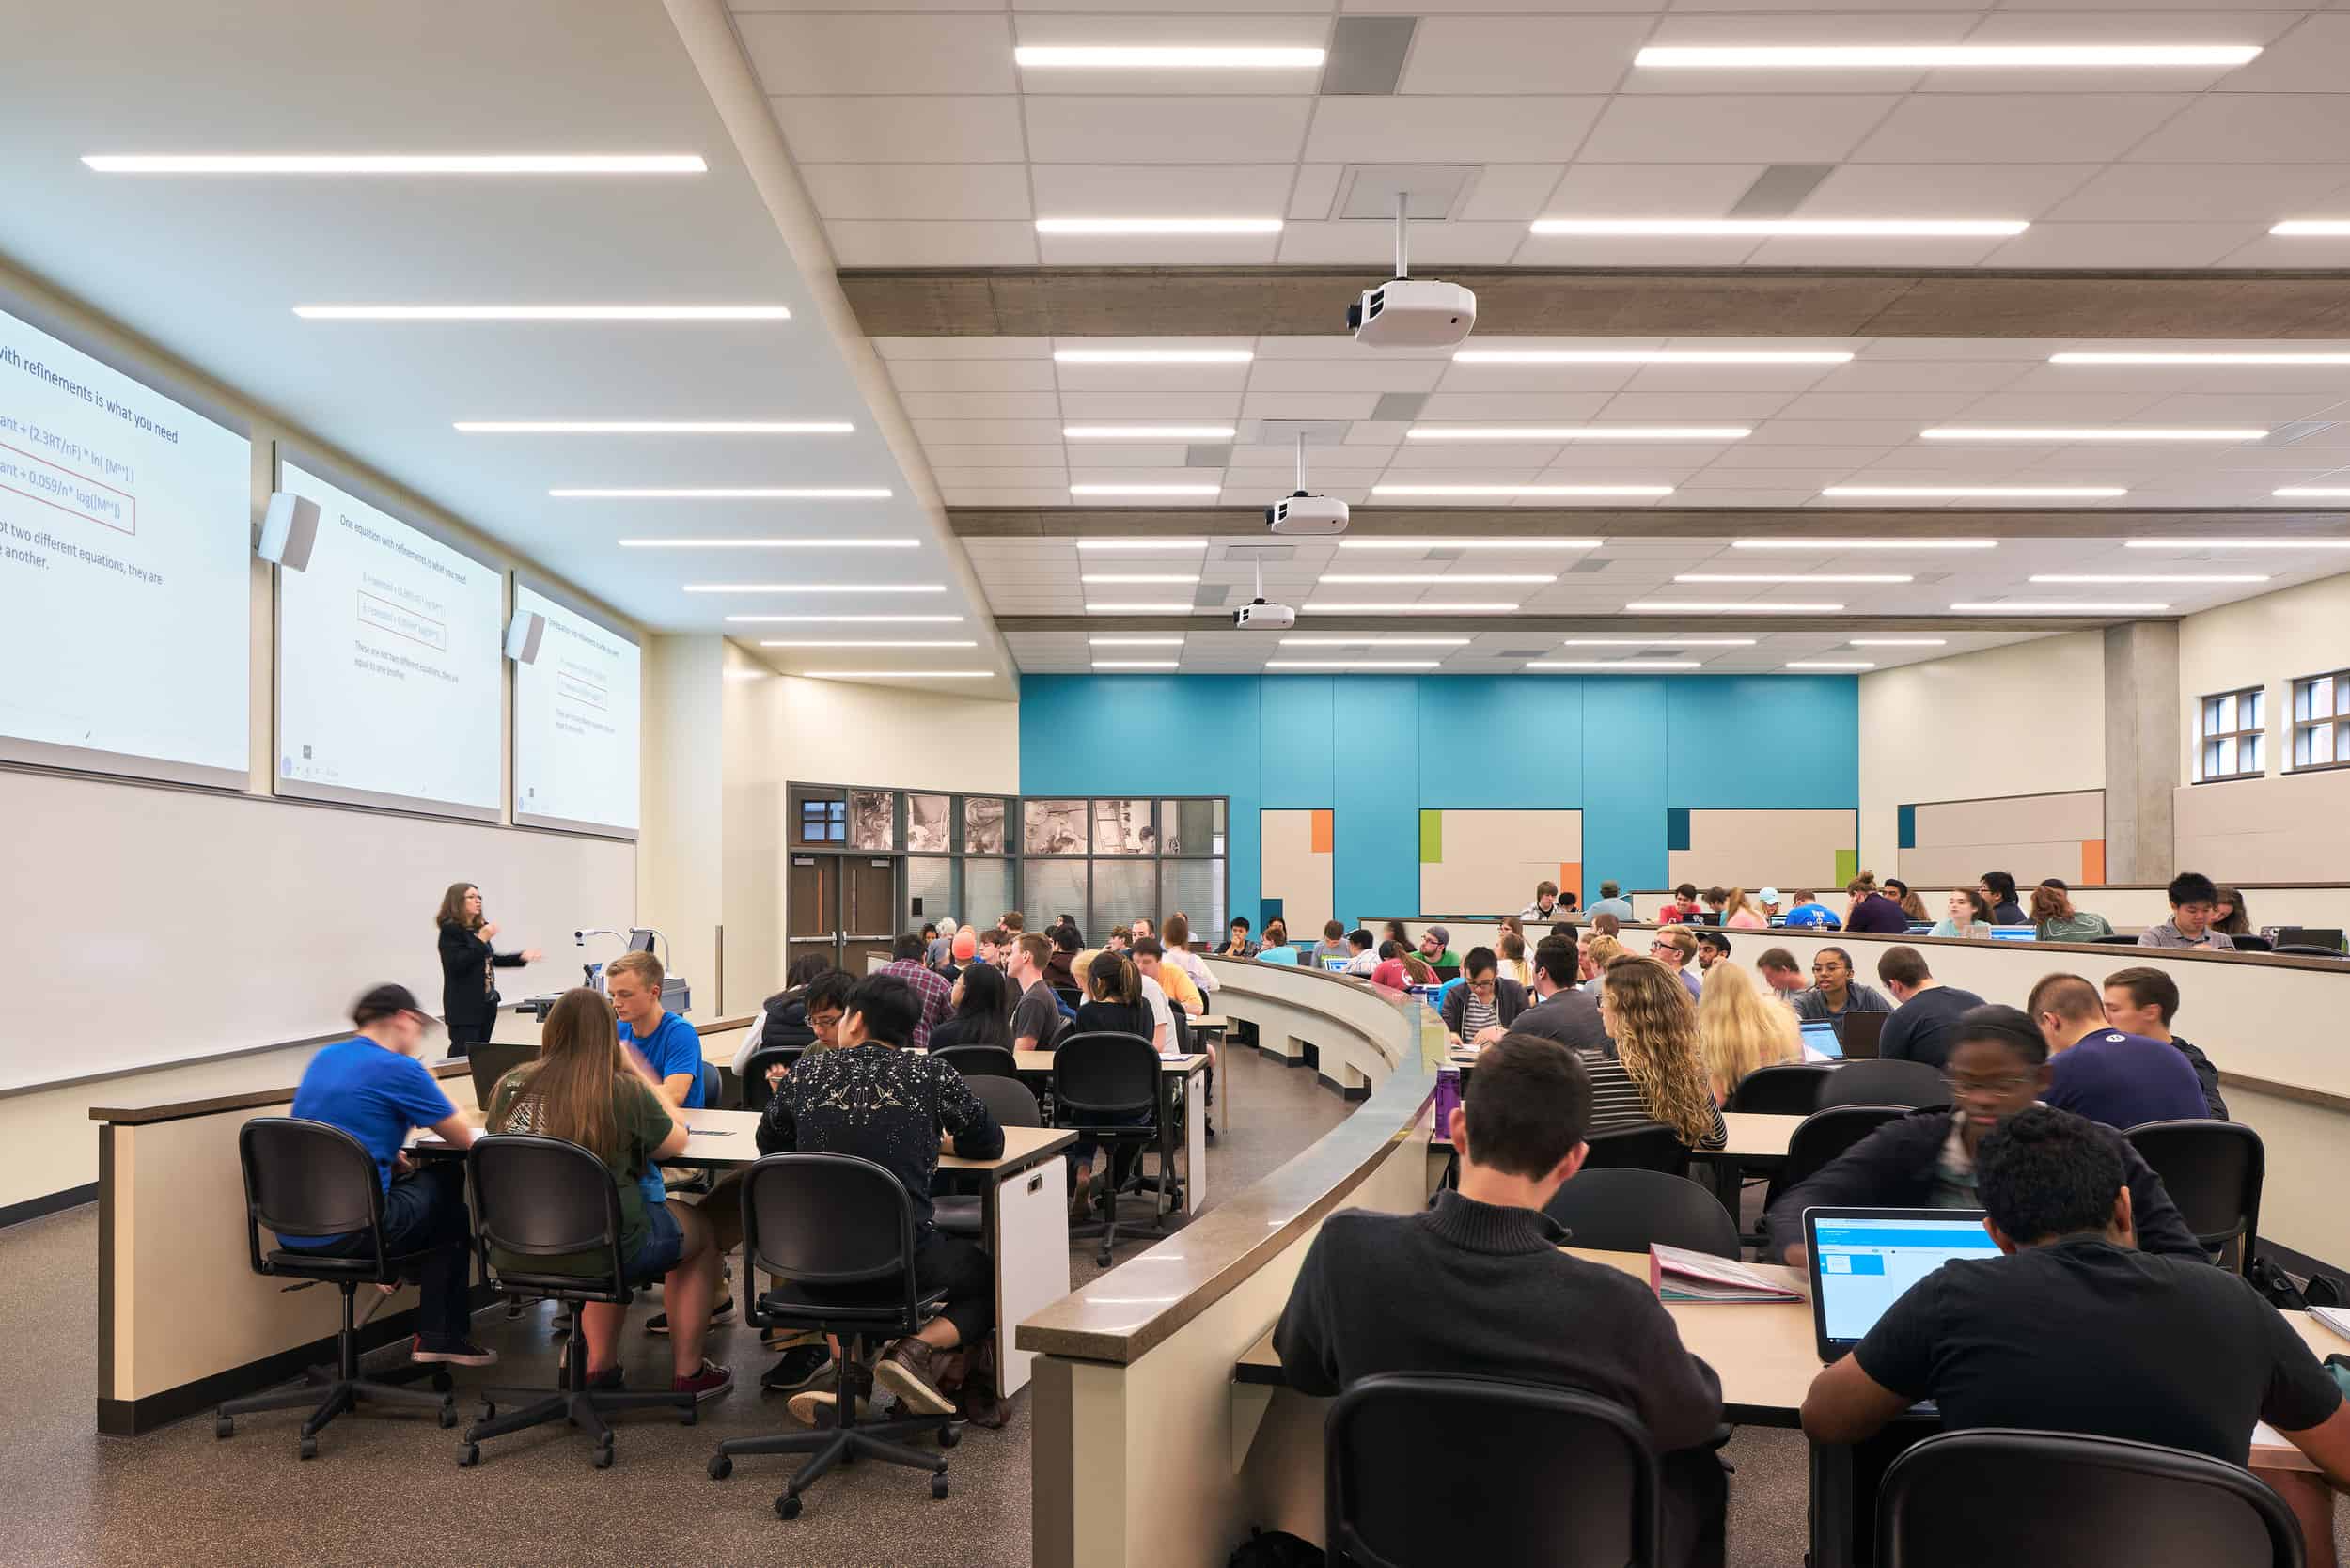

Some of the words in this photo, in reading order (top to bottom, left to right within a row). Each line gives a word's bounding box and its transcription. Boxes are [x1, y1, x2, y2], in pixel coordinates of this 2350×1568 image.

[24, 360, 93, 402] refinements
[95, 391, 103, 408] is
[106, 400, 132, 422] what
[134, 414, 151, 431] you
[155, 424, 178, 444] need
[5, 545, 49, 570] another.
[11, 523, 31, 541] two
[34, 531, 77, 557] different
[79, 549, 127, 575] equations,
[128, 564, 147, 582] they
[149, 572, 163, 585] are
